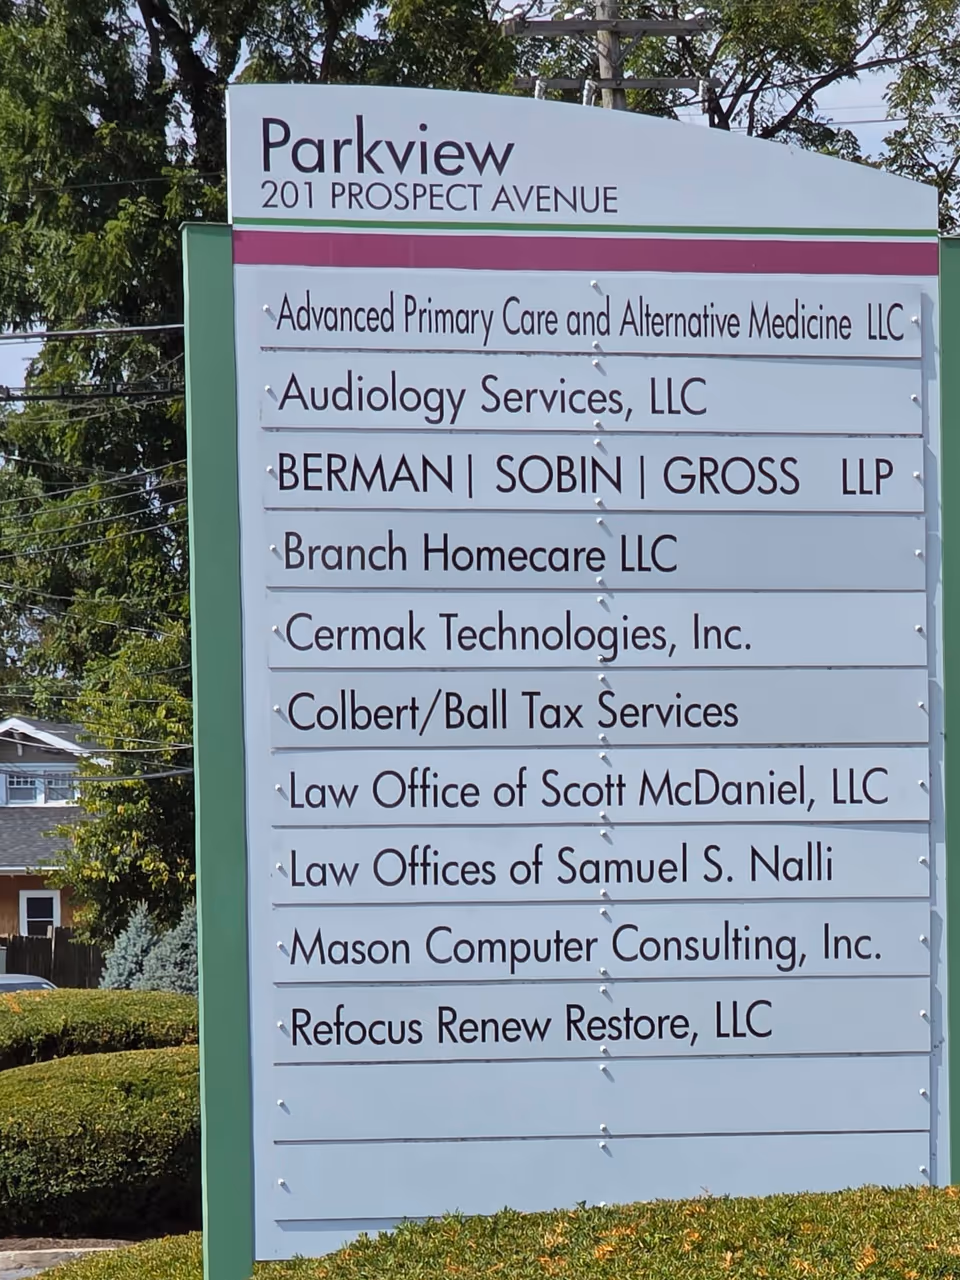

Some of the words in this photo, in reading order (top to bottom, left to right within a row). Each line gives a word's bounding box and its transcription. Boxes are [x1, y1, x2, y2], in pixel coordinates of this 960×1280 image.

[261, 114, 515, 177] Parkview
[260, 180, 314, 209] 201
[330, 181, 484, 212] PROSPECT
[490, 184, 619, 214] AVENUE
[276, 289, 395, 335] Advanced
[403, 294, 495, 347] Primary
[502, 295, 559, 337] Care
[565, 294, 612, 338] and
[618, 299, 741, 341] Alternative
[747, 301, 853, 342] Medicine
[867, 302, 906, 343] LLC
[277, 369, 467, 426] Audiology
[480, 374, 634, 423] Services,
[649, 377, 708, 417] LLC
[277, 452, 454, 494] BERMAN
[494, 454, 623, 495] SOBIN
[662, 455, 801, 497] GROSS
[841, 458, 895, 497] LLP
[283, 529, 408, 573] Branch
[422, 532, 607, 574] Homecare
[619, 534, 679, 574] LLC
[285, 608, 428, 653] Cermak
[437, 612, 678, 664] Technologies,
[692, 612, 753, 652] Inc.
[287, 687, 508, 738] Colbert/Ball
[520, 691, 585, 730] Tax
[596, 689, 740, 730] Services
[289, 771, 360, 810] Law
[371, 766, 481, 810] Office
[492, 765, 528, 809] of
[540, 768, 628, 809] Scott
[637, 764, 817, 814] McDaniel,
[830, 766, 890, 807] LLC
[290, 849, 361, 888] Law
[372, 844, 497, 888] Offices
[508, 843, 544, 886] of
[556, 842, 689, 886] Samuel
[702, 843, 734, 884] S.
[749, 840, 834, 884] Nalli
[289, 927, 411, 966] Mason
[424, 925, 600, 976] Computer
[611, 919, 808, 973] Consulting,
[823, 921, 884, 962] Inc.
[291, 1003, 424, 1048] Refocus
[437, 1005, 553, 1045] Renew
[565, 1002, 700, 1048] Restore,
[715, 999, 774, 1040] LLC
